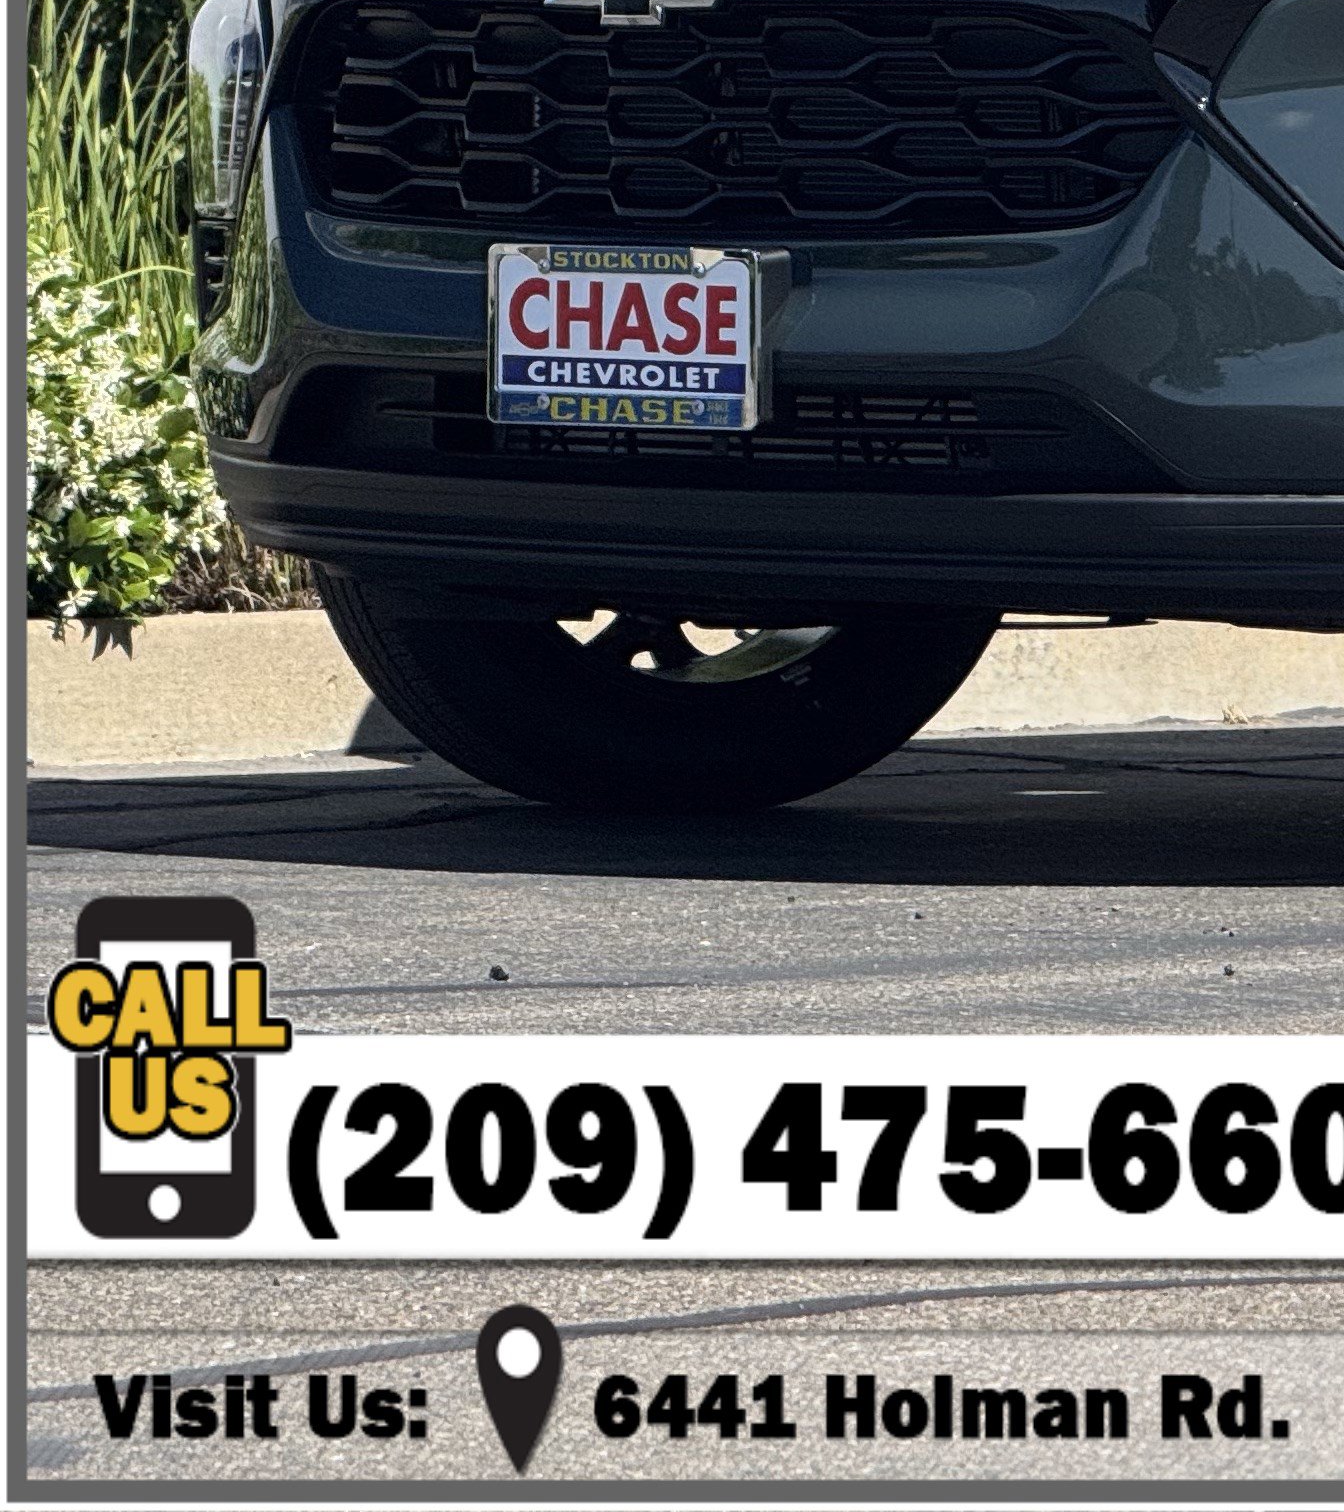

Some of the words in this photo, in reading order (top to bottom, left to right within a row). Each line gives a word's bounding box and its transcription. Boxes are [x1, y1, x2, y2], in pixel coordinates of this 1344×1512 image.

[553, 251, 691, 271] STOCKTON
[509, 276, 738, 356] CHASE
[527, 360, 720, 390] CHEVROLET
[550, 395, 695, 425] CHASE
